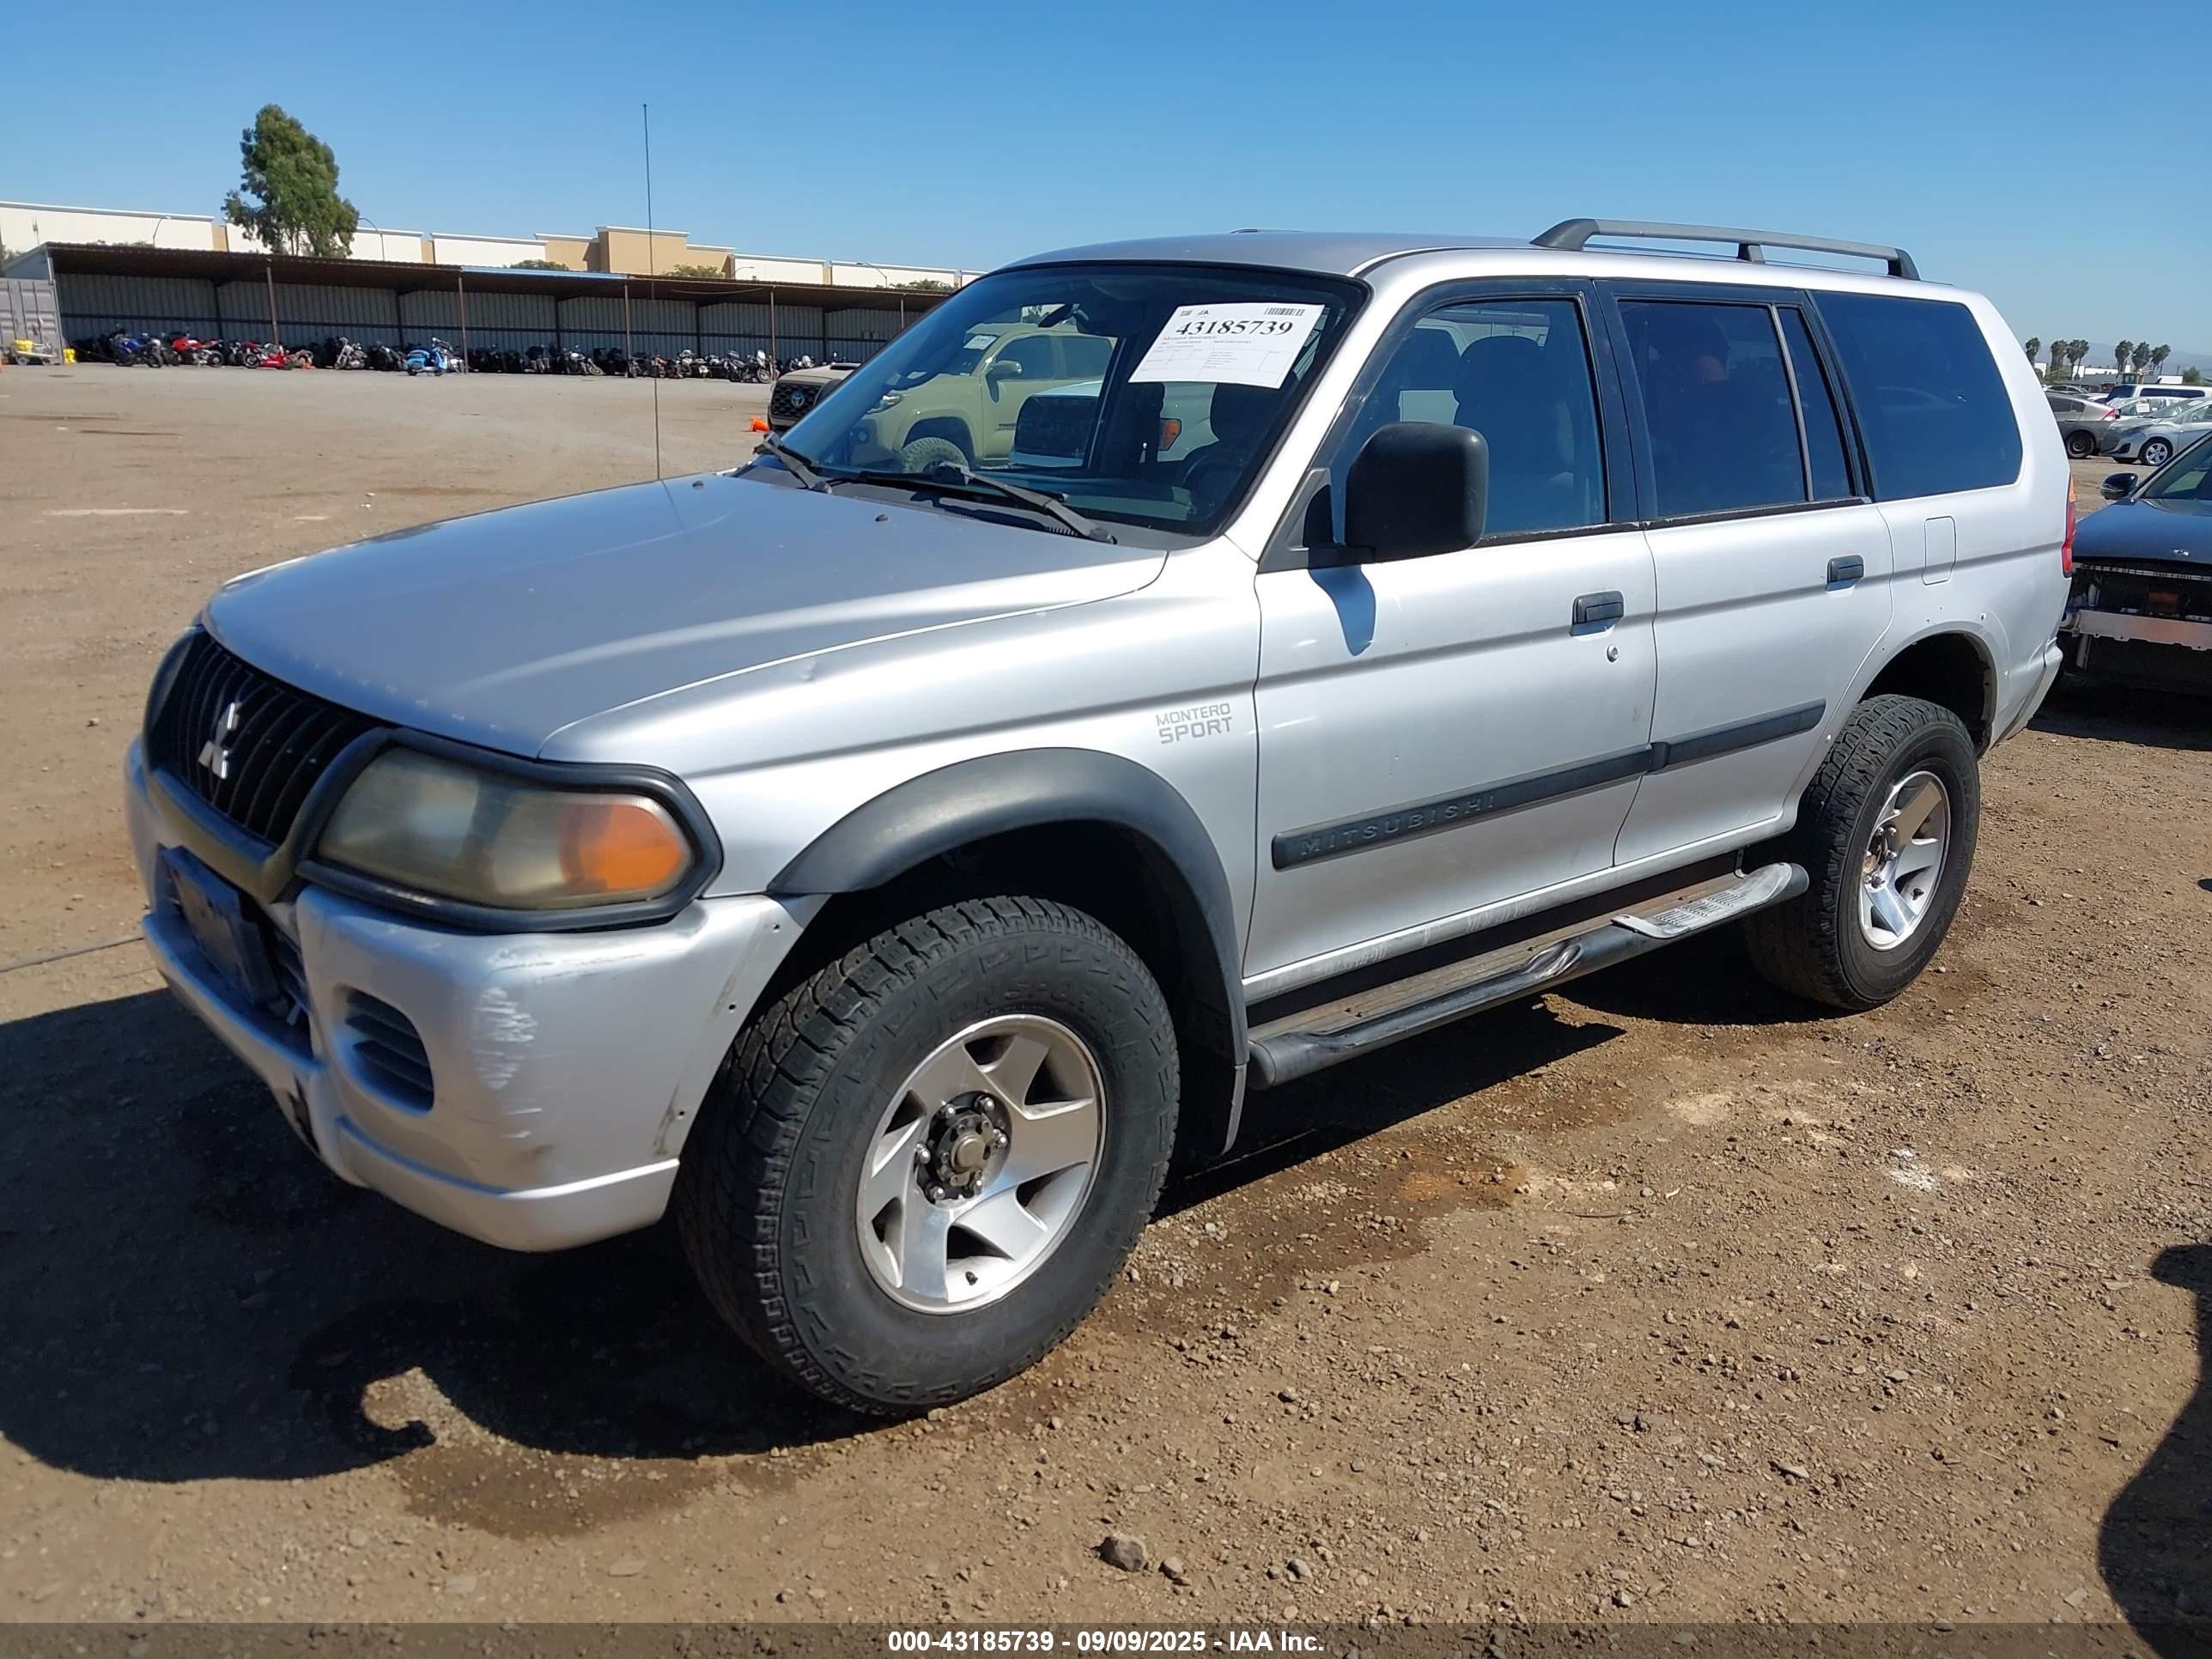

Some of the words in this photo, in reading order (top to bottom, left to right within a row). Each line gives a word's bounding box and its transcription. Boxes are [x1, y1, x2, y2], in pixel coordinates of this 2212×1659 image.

[1175, 319, 1293, 336] 43185739
[1155, 702, 1231, 726] MONTERO
[1159, 716, 1232, 744] SPORT
[1299, 794, 1497, 856] MITSUBISHI
